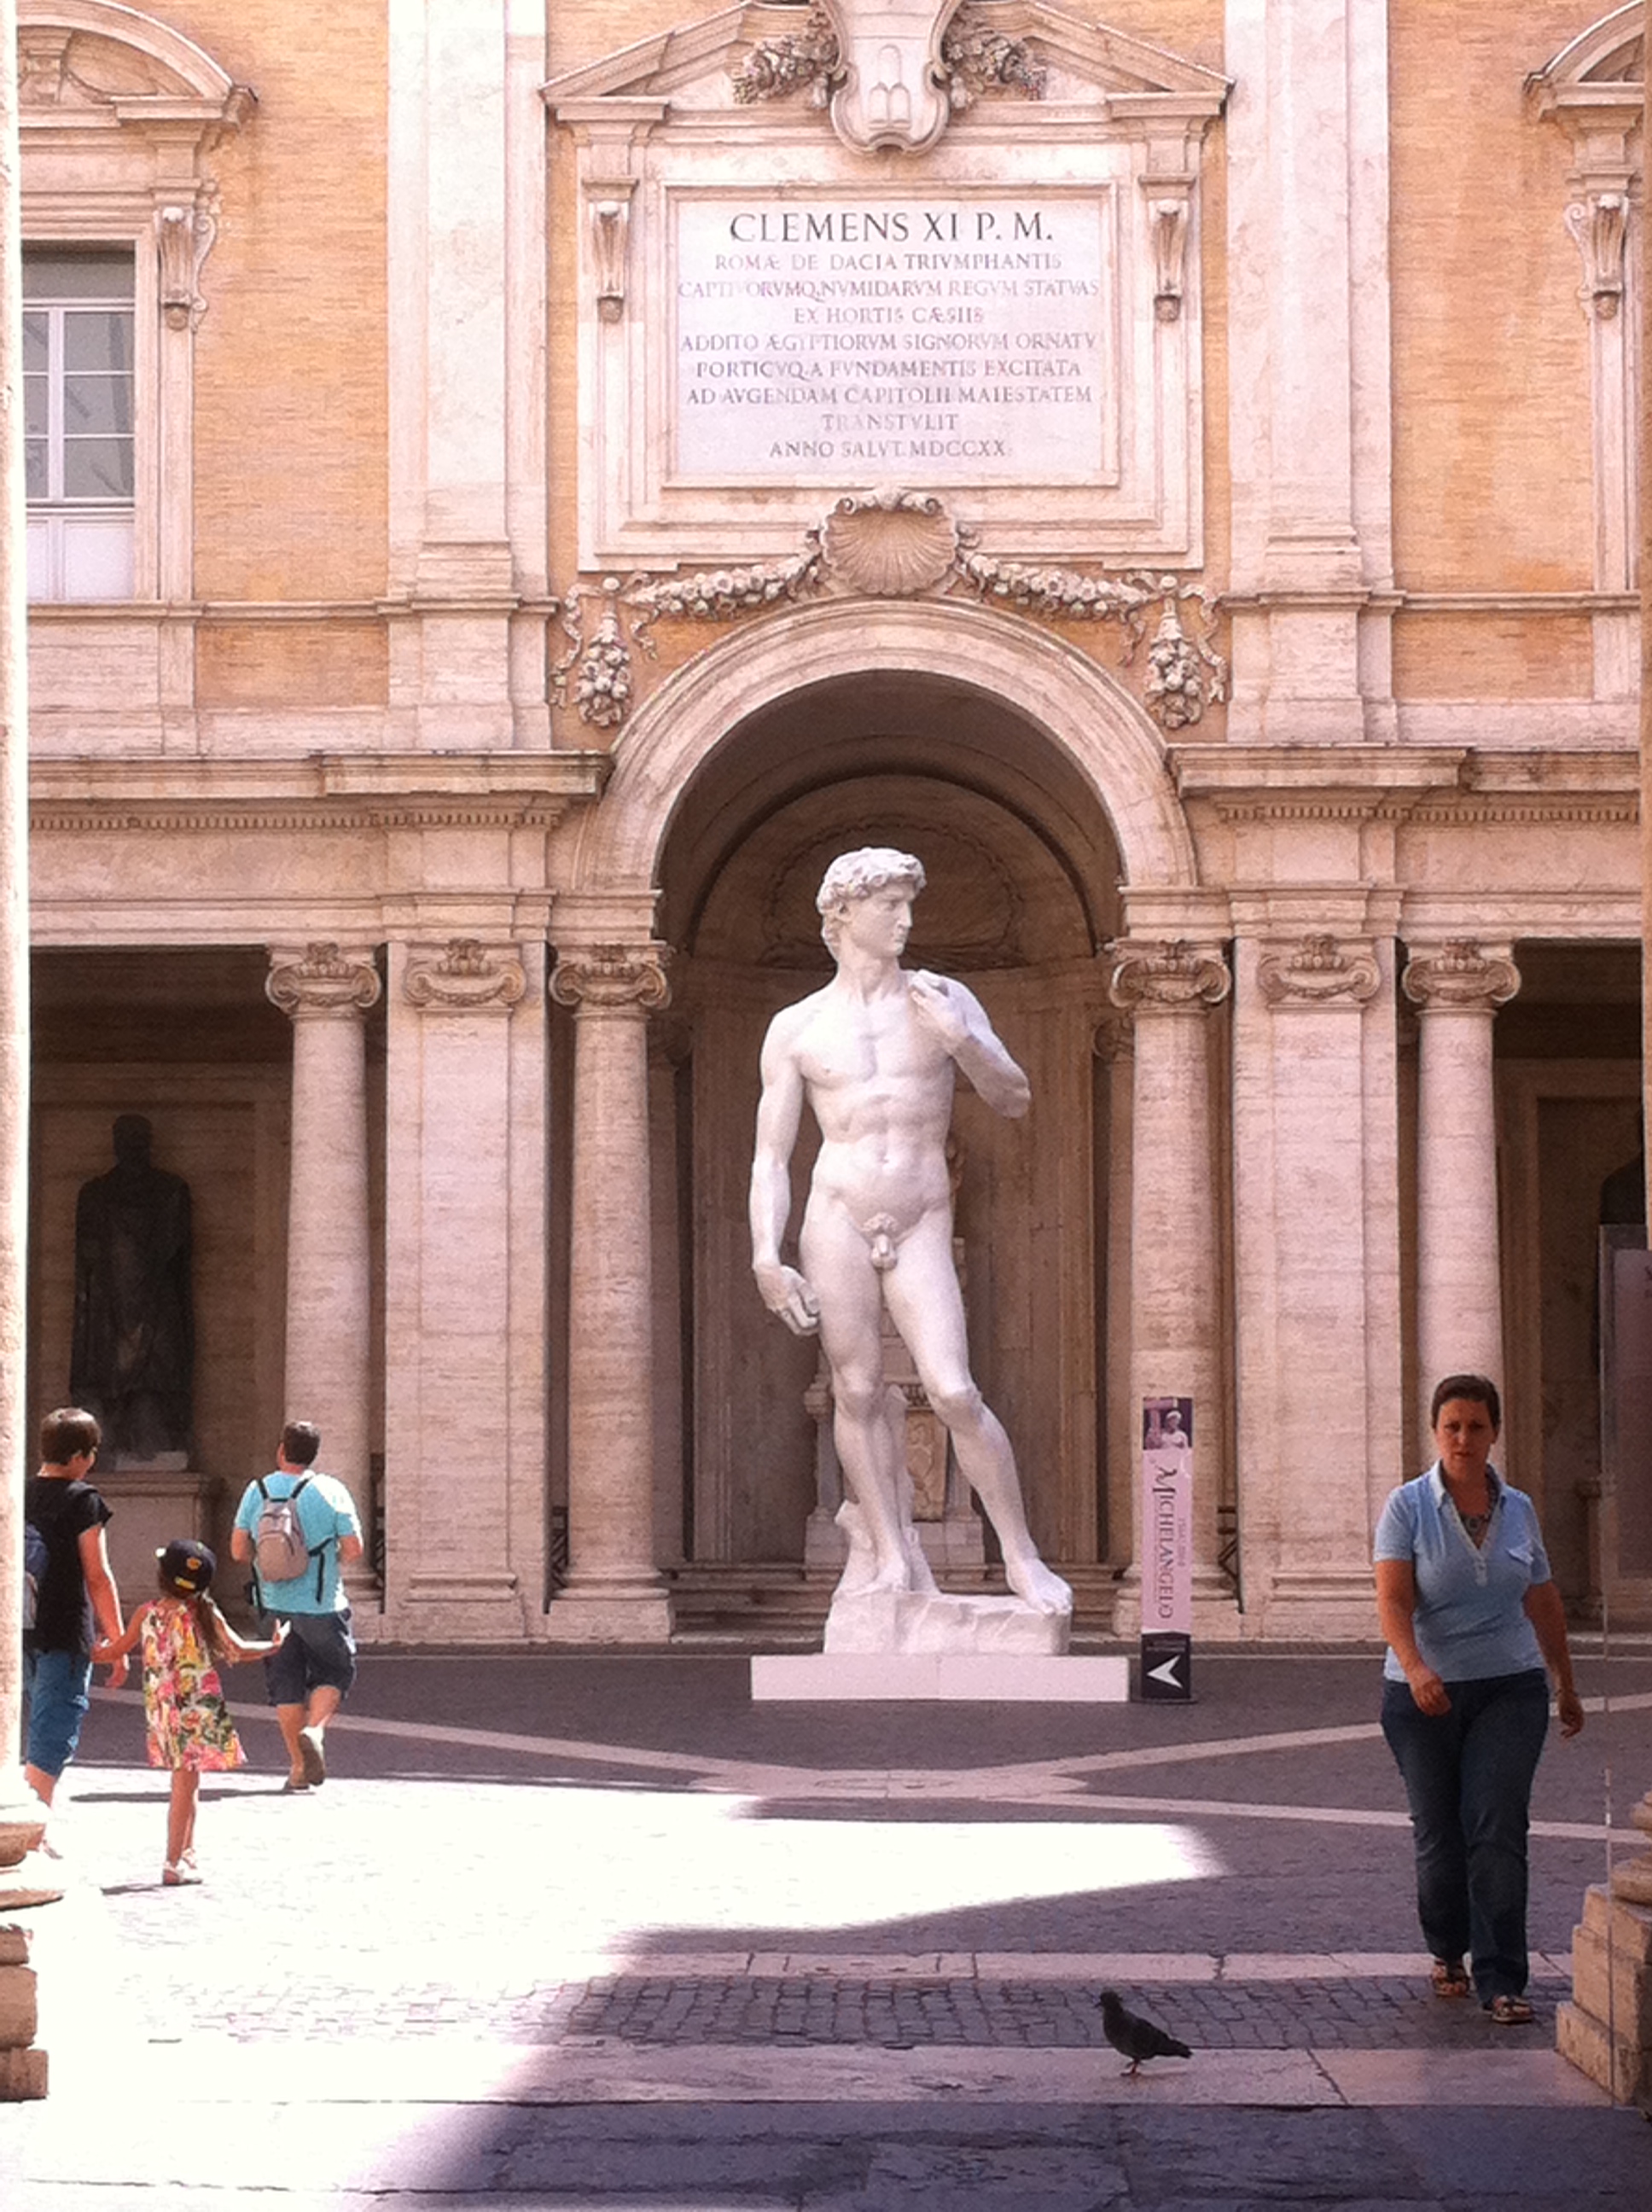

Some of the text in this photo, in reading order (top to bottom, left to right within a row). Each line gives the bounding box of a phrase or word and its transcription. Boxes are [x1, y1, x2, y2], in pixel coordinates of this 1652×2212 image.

[730, 211, 1053, 242] CLEMENS XI P. M.
[791, 253, 819, 271] DE
[829, 253, 898, 271] DACIA
[904, 253, 1062, 270] TRIVMPHANTIS
[948, 280, 1019, 297] REGVM
[1023, 279, 1100, 297] STATVAS
[794, 307, 820, 324] EX
[826, 307, 905, 324] HORTIS
[681, 334, 759, 352] ADDITO
[902, 333, 1009, 351] SIGNORVM
[1015, 333, 1097, 350] ORNATV
[829, 360, 977, 378] FVNDAMENTIS
[984, 359, 1082, 377] EXCITATA
[686, 386, 1093, 405] AD AVGENDAM CAPITOLII MAIESTATEM
[821, 413, 959, 432] TRANSTVLIT
[769, 440, 835, 458] ANNO
[1152, 1464, 1178, 1620] MICHELANGELO
